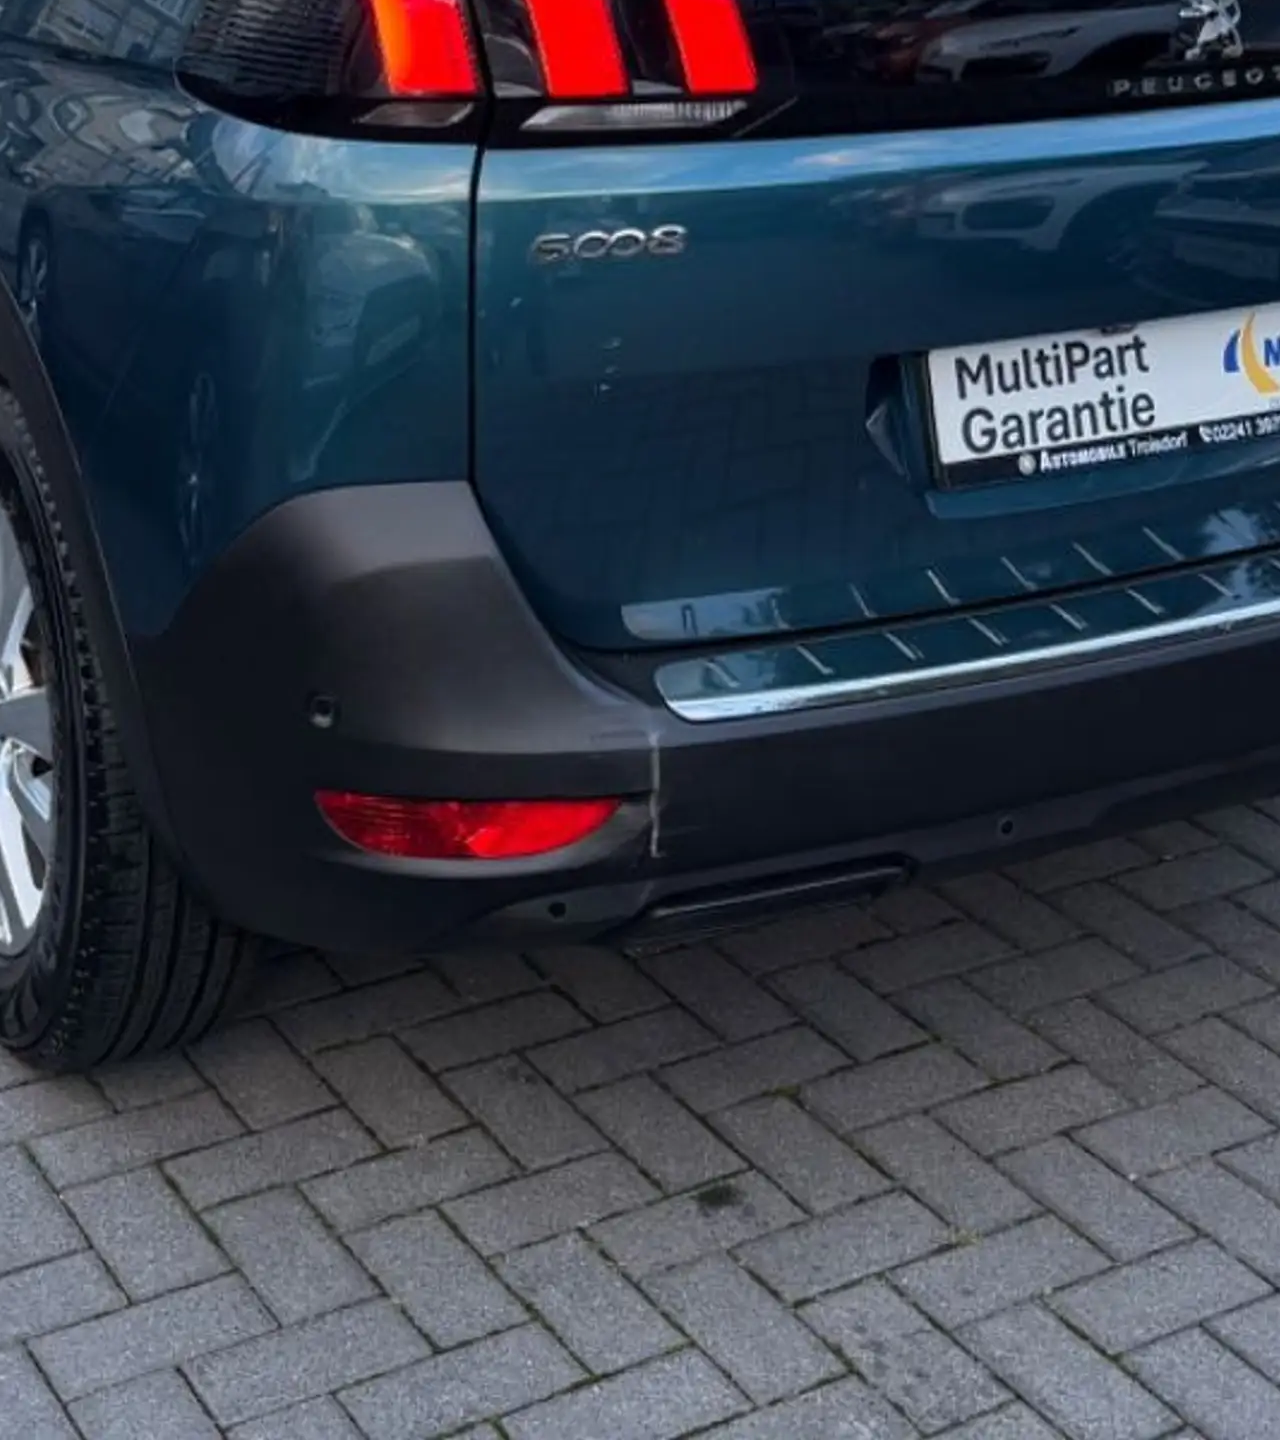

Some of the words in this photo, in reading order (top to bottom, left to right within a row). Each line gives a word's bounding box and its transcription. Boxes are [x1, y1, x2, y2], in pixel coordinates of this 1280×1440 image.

[530, 223, 689, 261] 5008
[955, 335, 1150, 401] MultiPart
[962, 386, 1156, 454] Garantie
